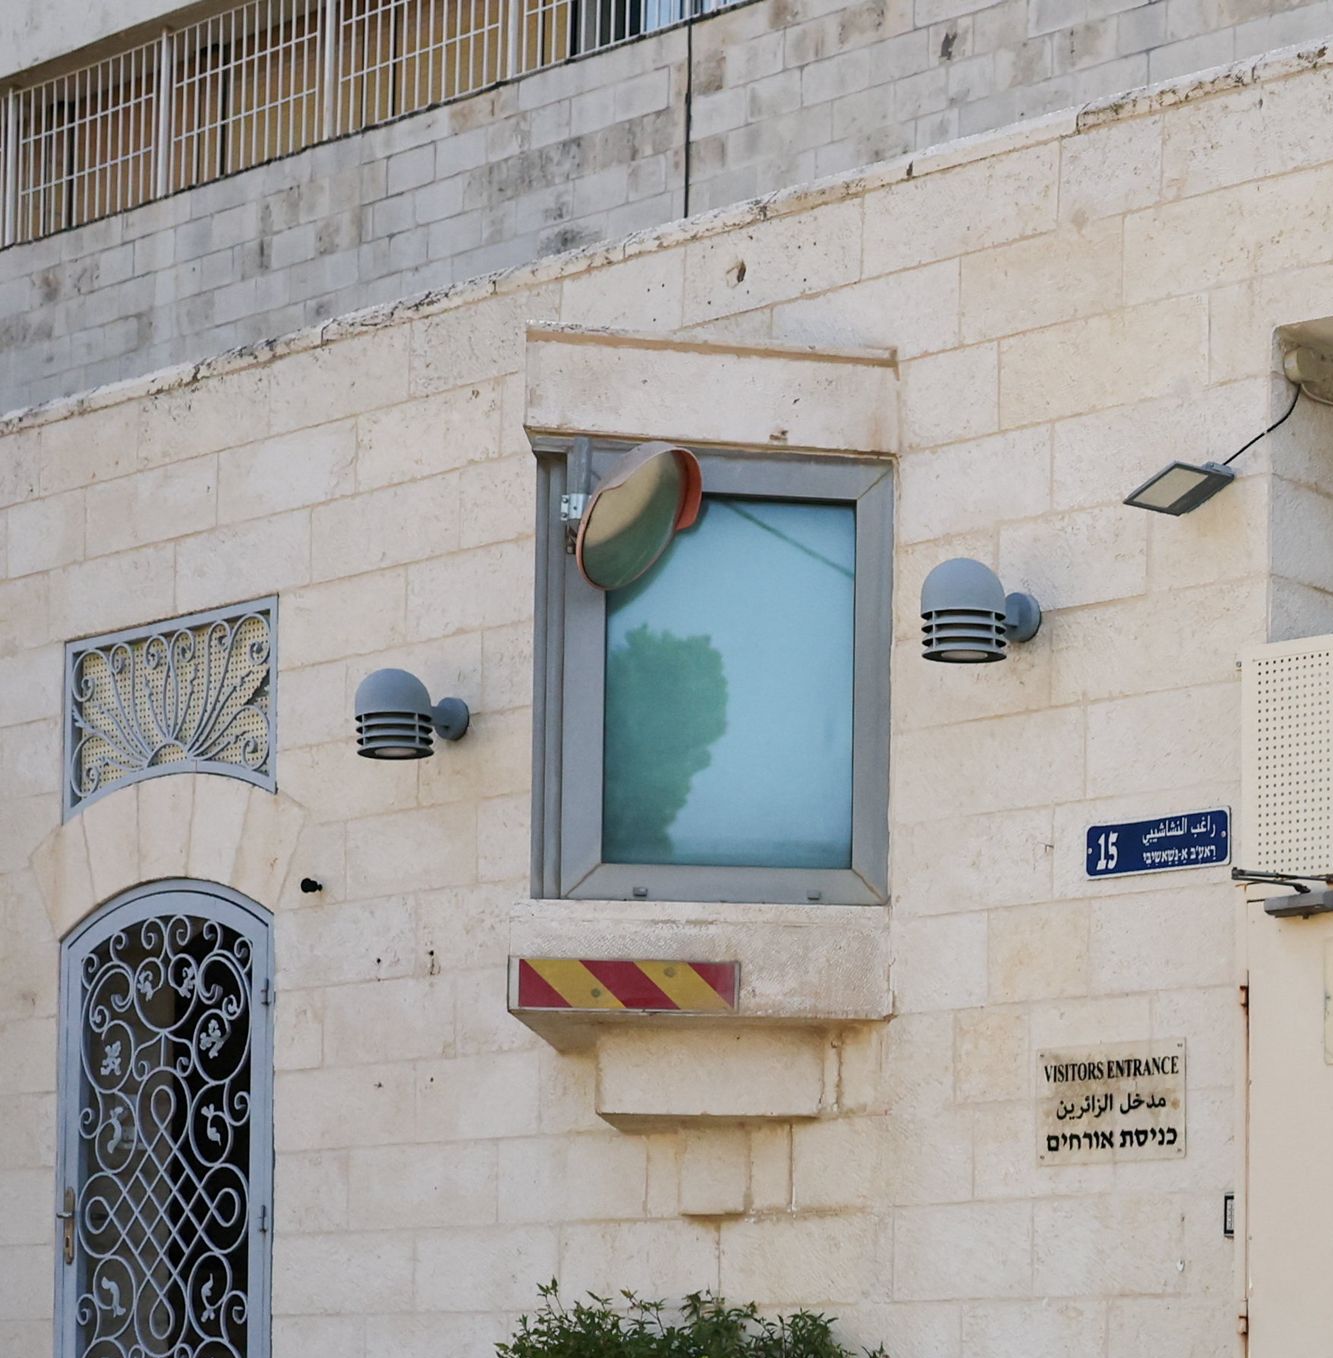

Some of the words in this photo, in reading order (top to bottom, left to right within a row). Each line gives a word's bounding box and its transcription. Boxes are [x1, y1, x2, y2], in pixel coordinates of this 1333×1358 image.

[1190, 815, 1216, 838] راغب
[1096, 831, 1118, 871] 15
[1044, 1060, 1104, 1083] VISITORS
[1107, 1056, 1179, 1079] ENTRANCE
[1056, 1093, 1113, 1120] الزائرين
[1119, 1093, 1166, 1115] مدخل
[1046, 1130, 1114, 1152] אורחים
[1119, 1127, 1178, 1148] כניסת
